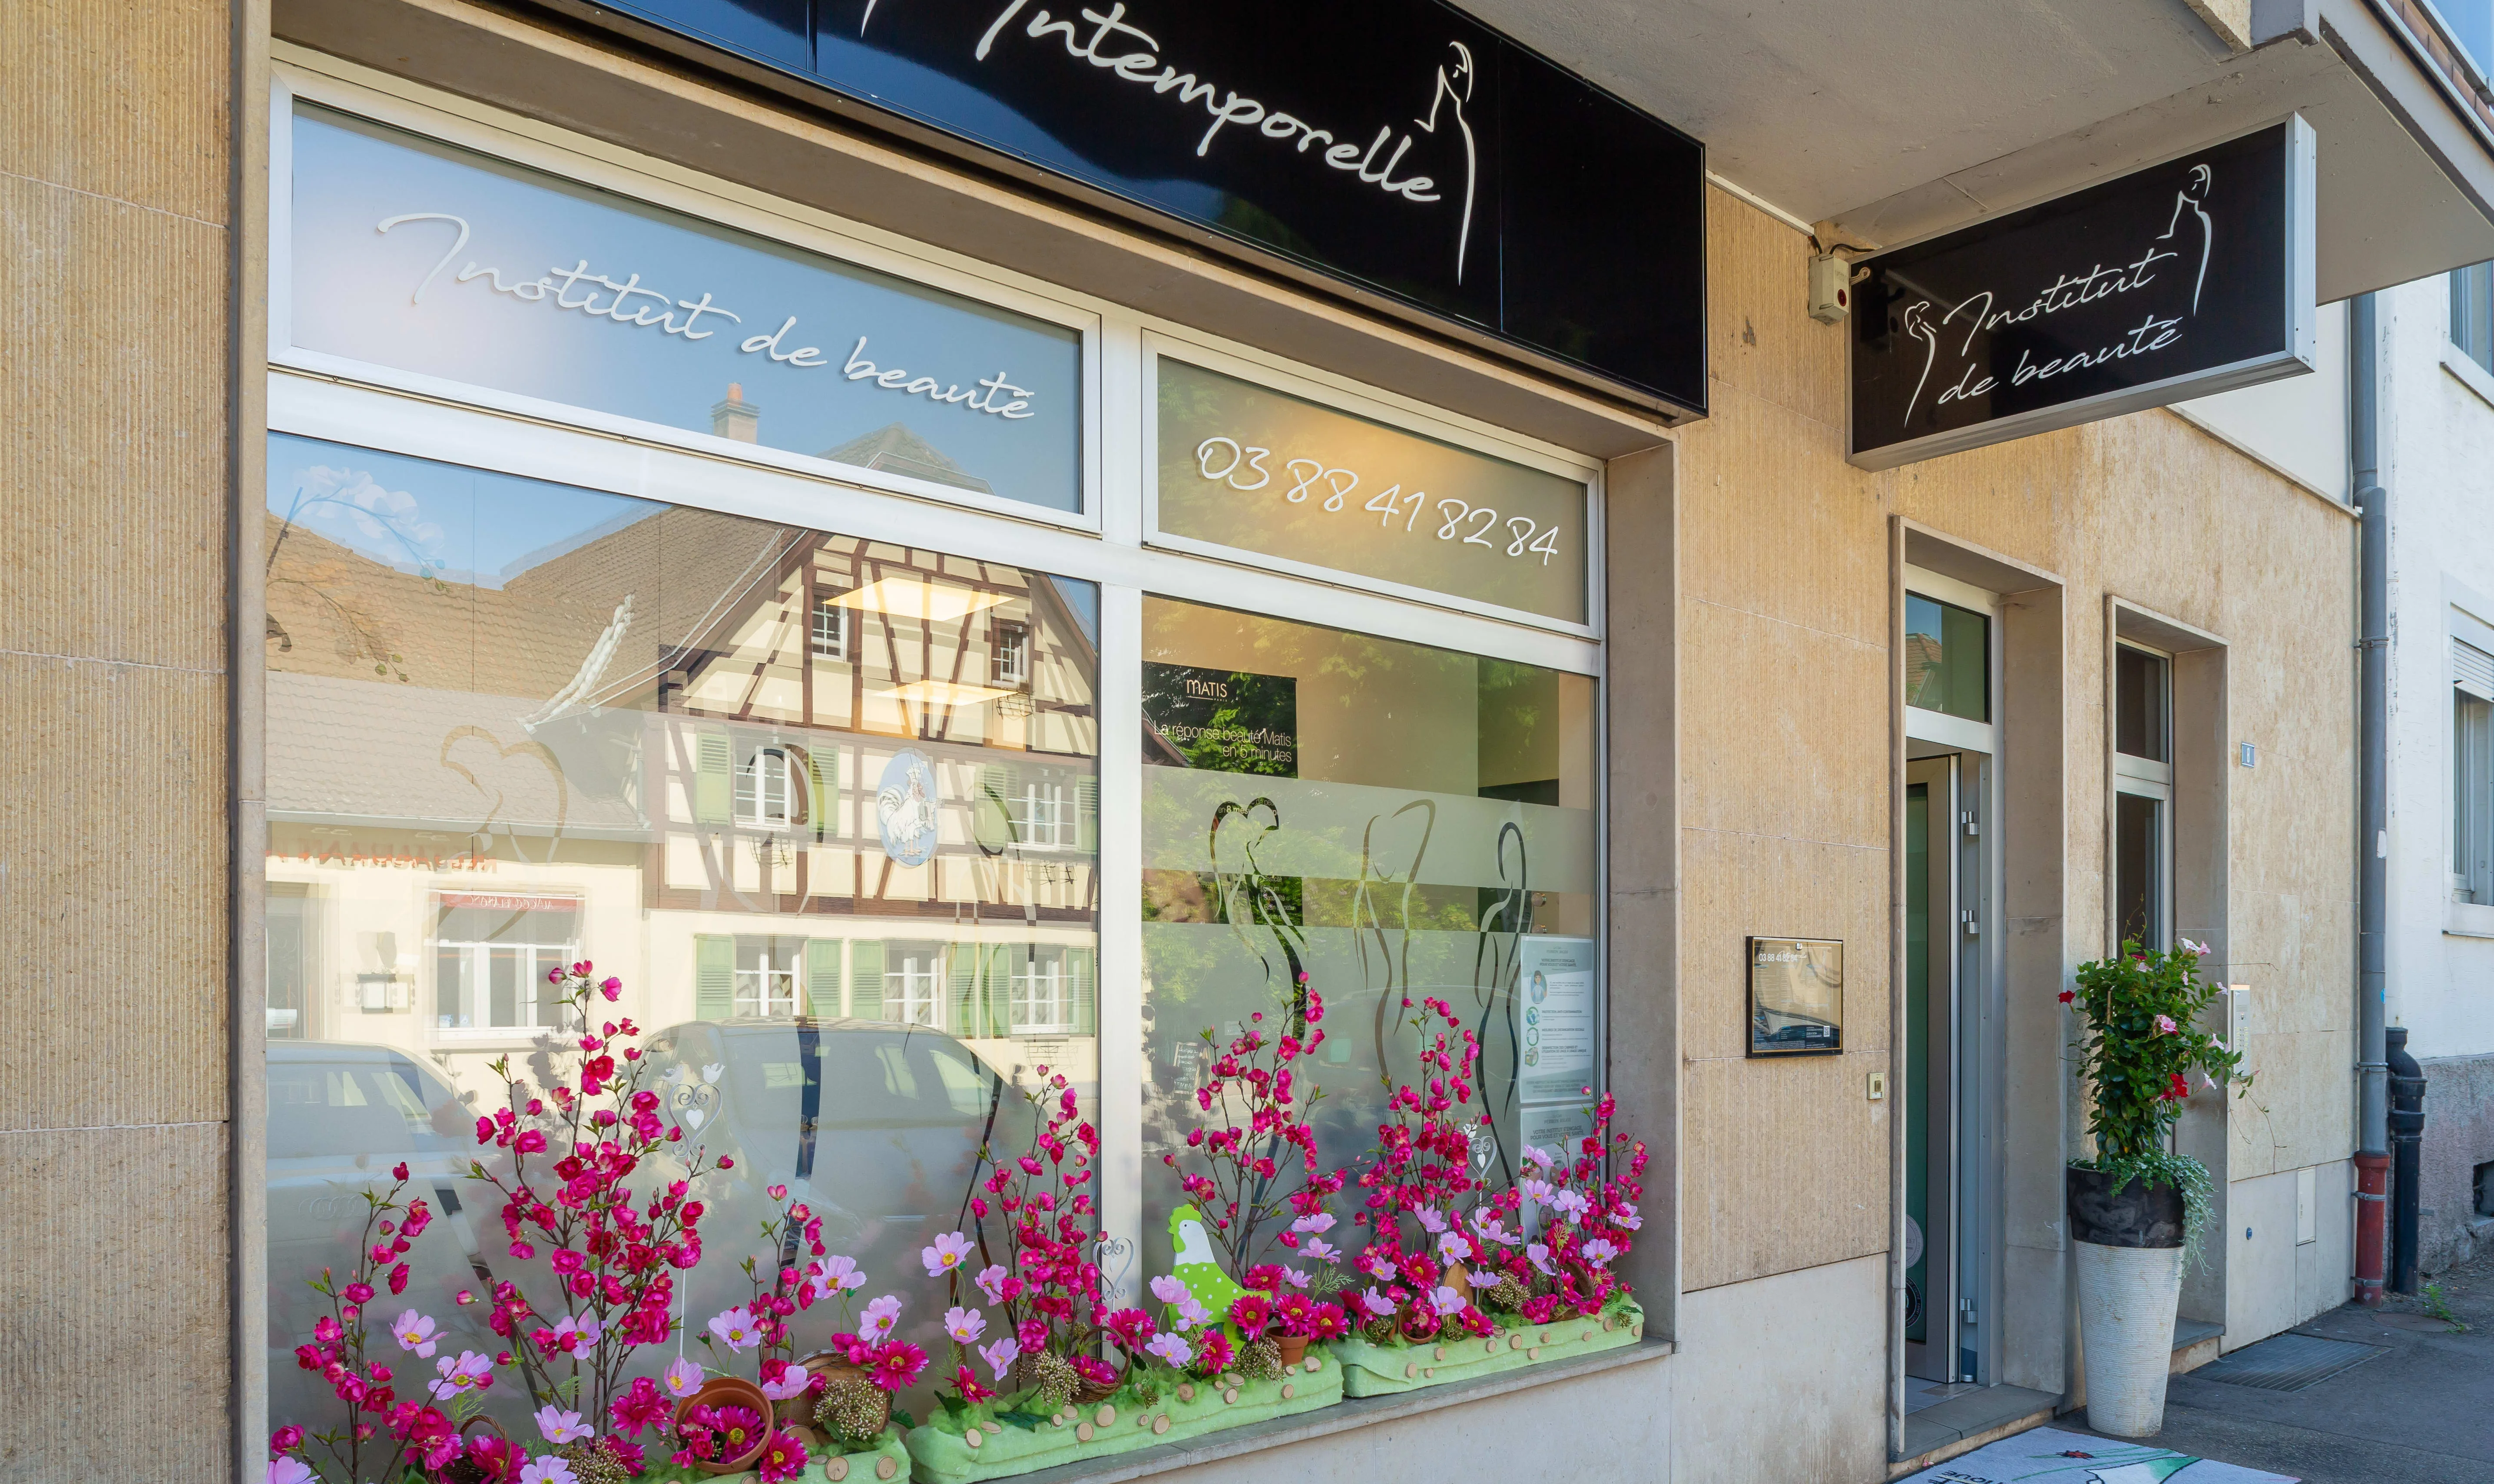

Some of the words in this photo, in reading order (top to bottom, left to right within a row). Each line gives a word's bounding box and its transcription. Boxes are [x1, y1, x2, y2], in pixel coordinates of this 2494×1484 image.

[377, 212, 741, 339] Institut
[741, 316, 828, 368] de
[845, 336, 1035, 420] beauté
[1943, 248, 2178, 357] Institut
[1938, 363, 1999, 405] de
[2011, 314, 2184, 387] beauté
[1197, 437, 1270, 491] 03
[1286, 458, 1358, 513] 88
[1365, 484, 1425, 532] 41
[1437, 498, 1498, 549] 82
[1506, 516, 1559, 566] 84
[1154, 720, 1169, 735] La
[1172, 722, 1220, 740] réponse
[1223, 726, 1261, 744] beauté
[1264, 730, 1292, 747] Matis
[1222, 745, 1237, 758] en
[1240, 744, 1247, 758] 5
[1251, 746, 1292, 762] minutes
